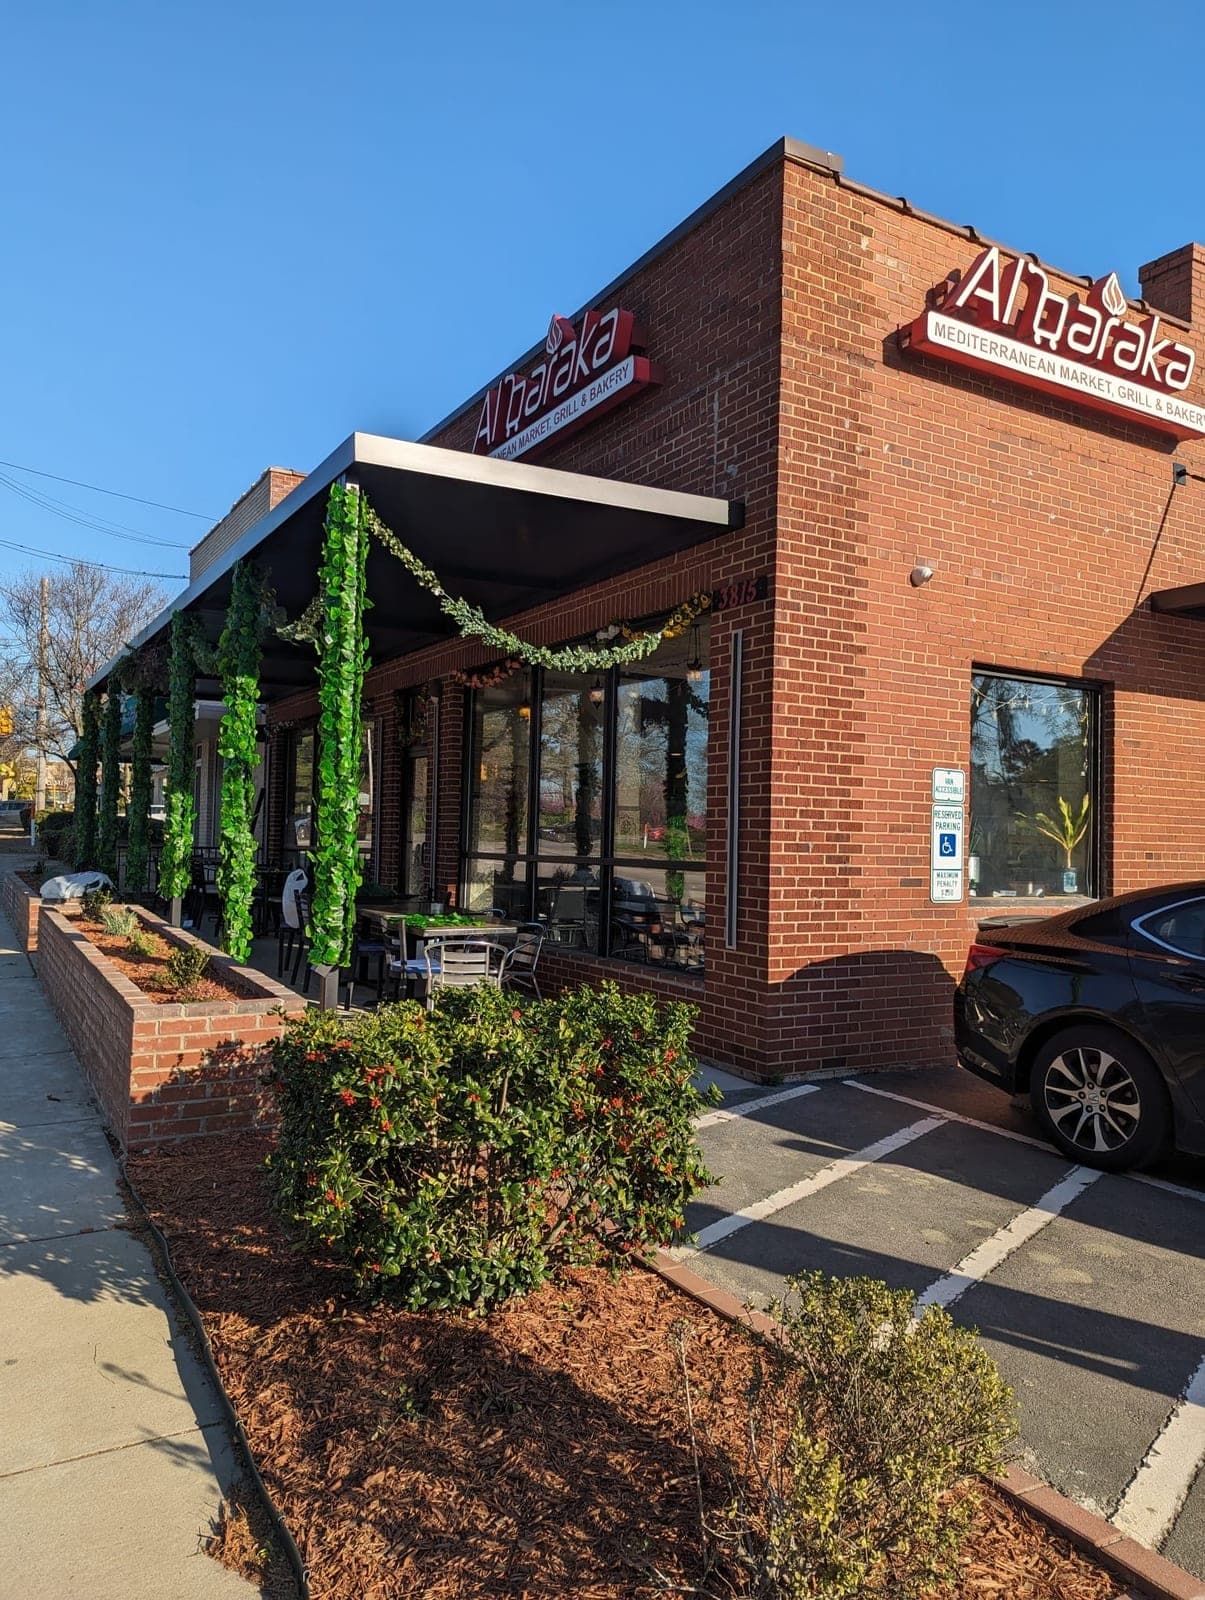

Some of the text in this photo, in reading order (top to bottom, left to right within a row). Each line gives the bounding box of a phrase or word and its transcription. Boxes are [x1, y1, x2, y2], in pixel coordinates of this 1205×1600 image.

[934, 321, 1205, 427] MEDITERRANEAN MARKET, GRILL & BAKER
[554, 401, 579, 425] GRILL
[581, 393, 588, 407] &
[718, 579, 757, 609] 3815
[935, 785, 963, 794] ACCESSIBLE
[934, 809, 963, 820] RESERVED
[935, 821, 961, 831] PARKING
[936, 871, 959, 879] MAXIMUM
[936, 880, 958, 888] PENALTY
